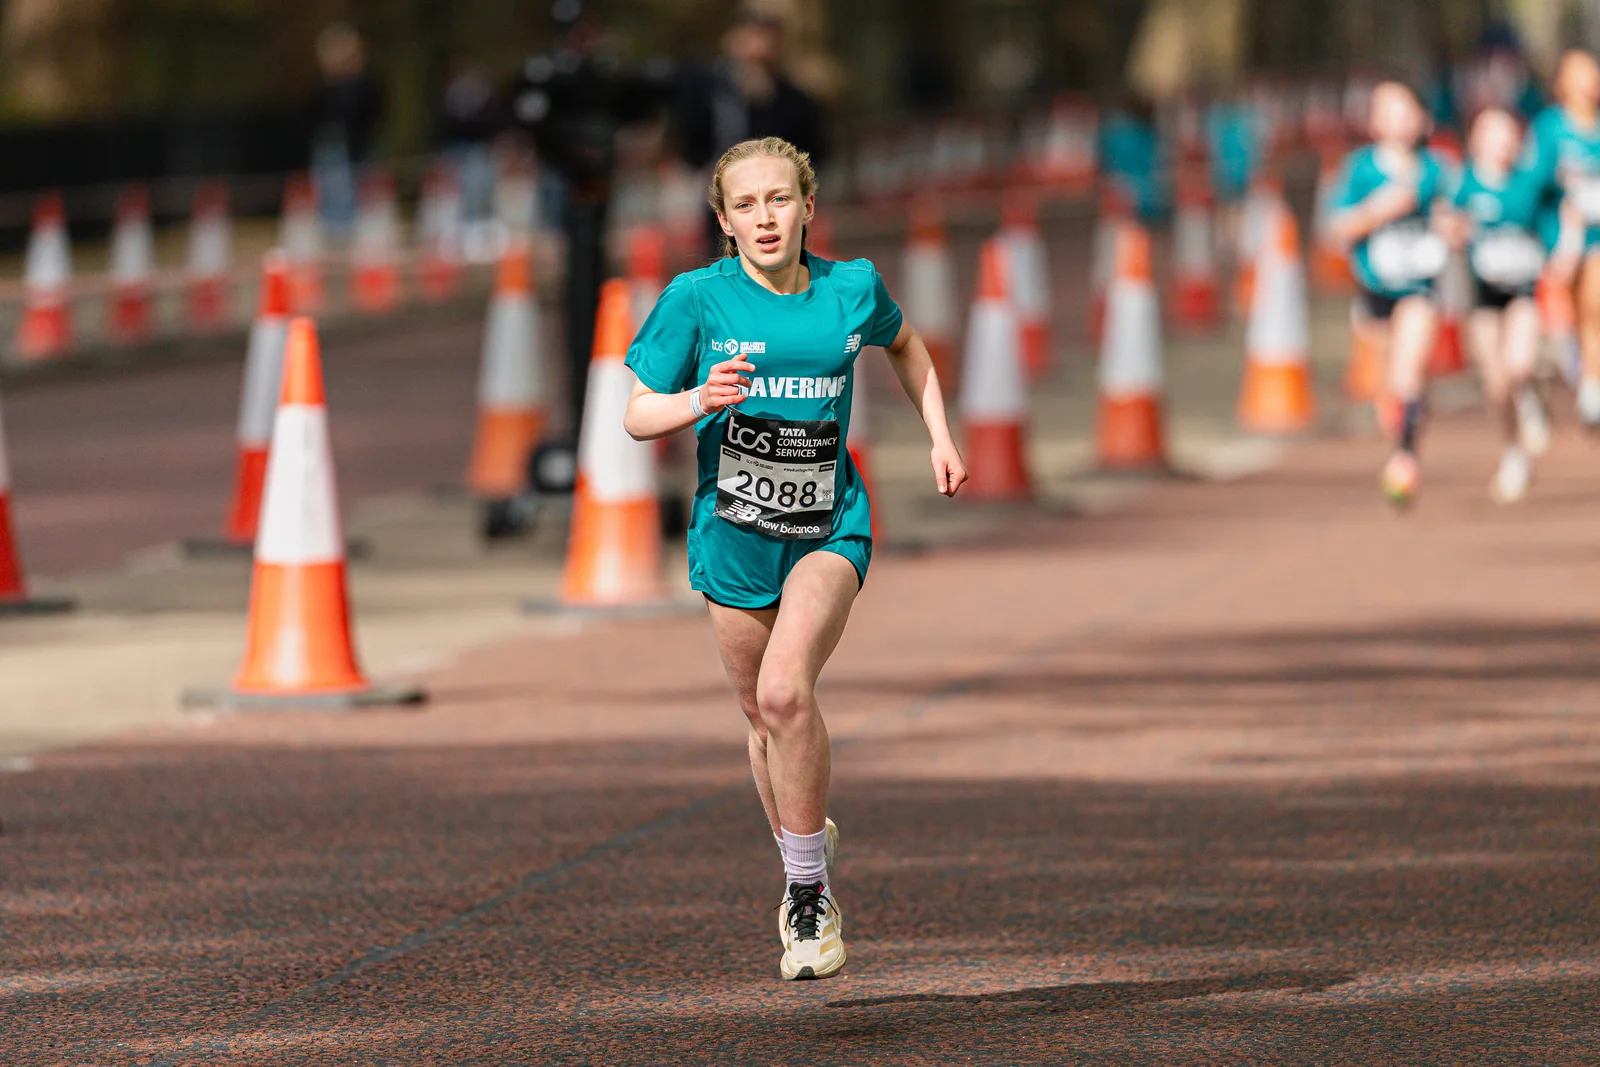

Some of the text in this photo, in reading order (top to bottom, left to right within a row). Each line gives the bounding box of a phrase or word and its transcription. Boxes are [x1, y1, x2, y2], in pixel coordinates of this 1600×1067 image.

[712, 339, 723, 351] tcs
[728, 416, 771, 453] tcs
[779, 428, 806, 437] TATA
[776, 437, 838, 448] CONSULTANCY
[775, 448, 816, 458] SERVICES
[735, 470, 817, 508] 2088
[757, 518, 820, 534] new balance
